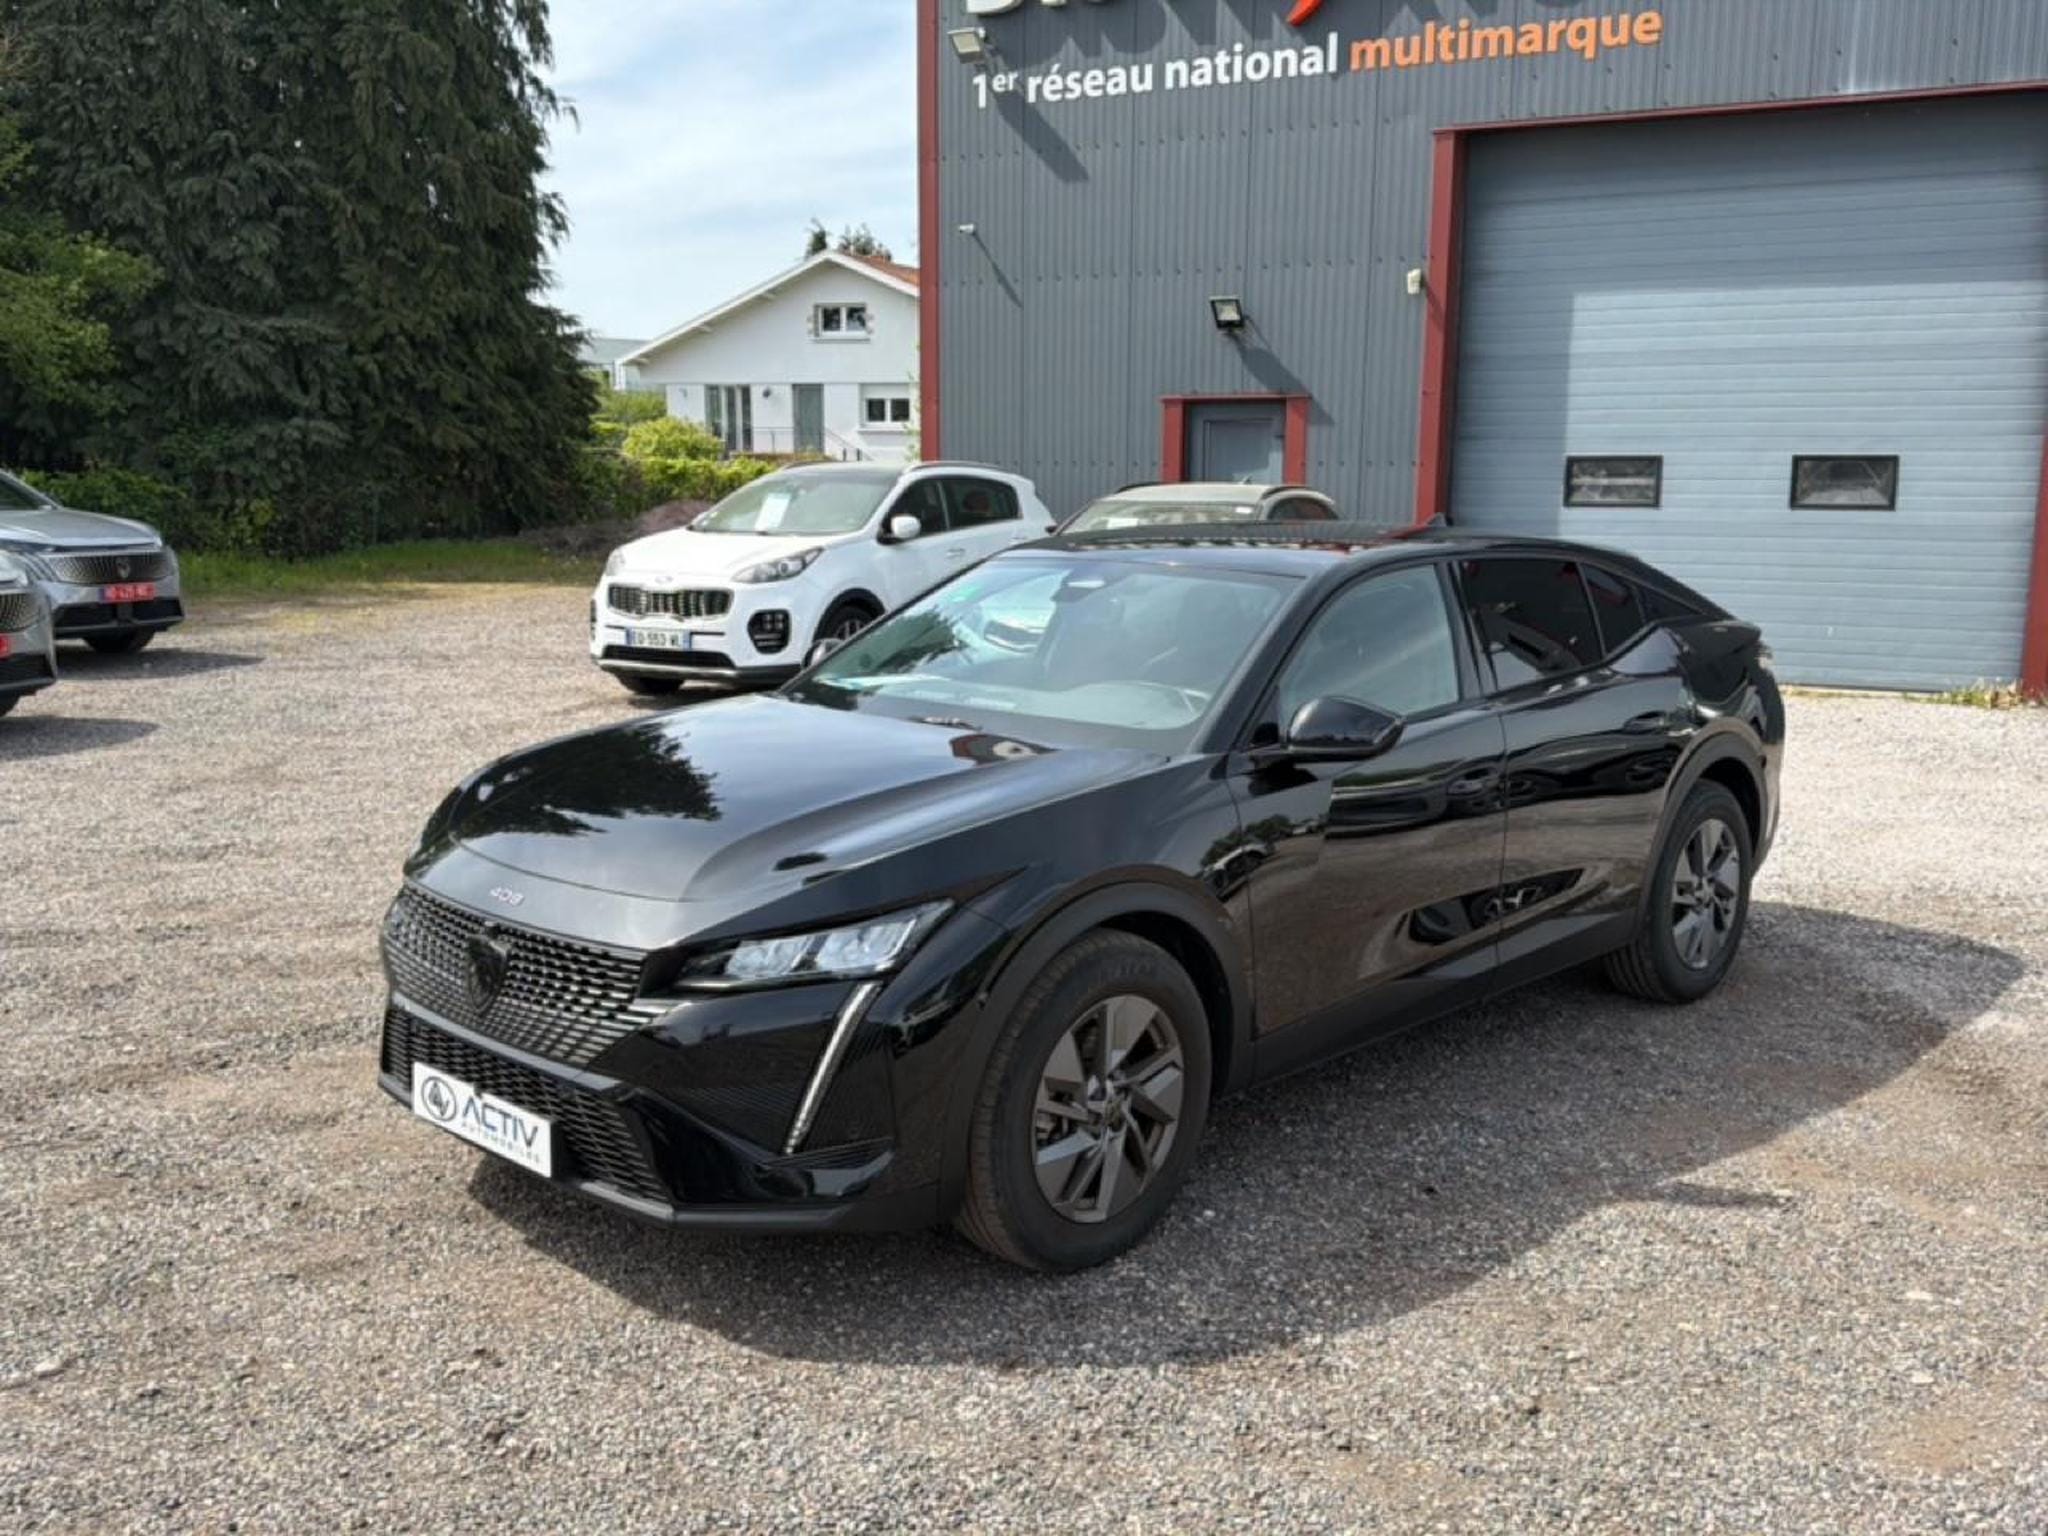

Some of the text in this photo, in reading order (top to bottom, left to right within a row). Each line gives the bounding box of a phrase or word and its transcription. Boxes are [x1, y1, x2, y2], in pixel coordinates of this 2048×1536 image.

[973, 71, 1018, 108] 1er
[1026, 63, 1153, 103] réseau
[1164, 31, 1338, 90] national
[1350, 9, 1663, 70] multimarque
[463, 1096, 538, 1149] ACTIV
